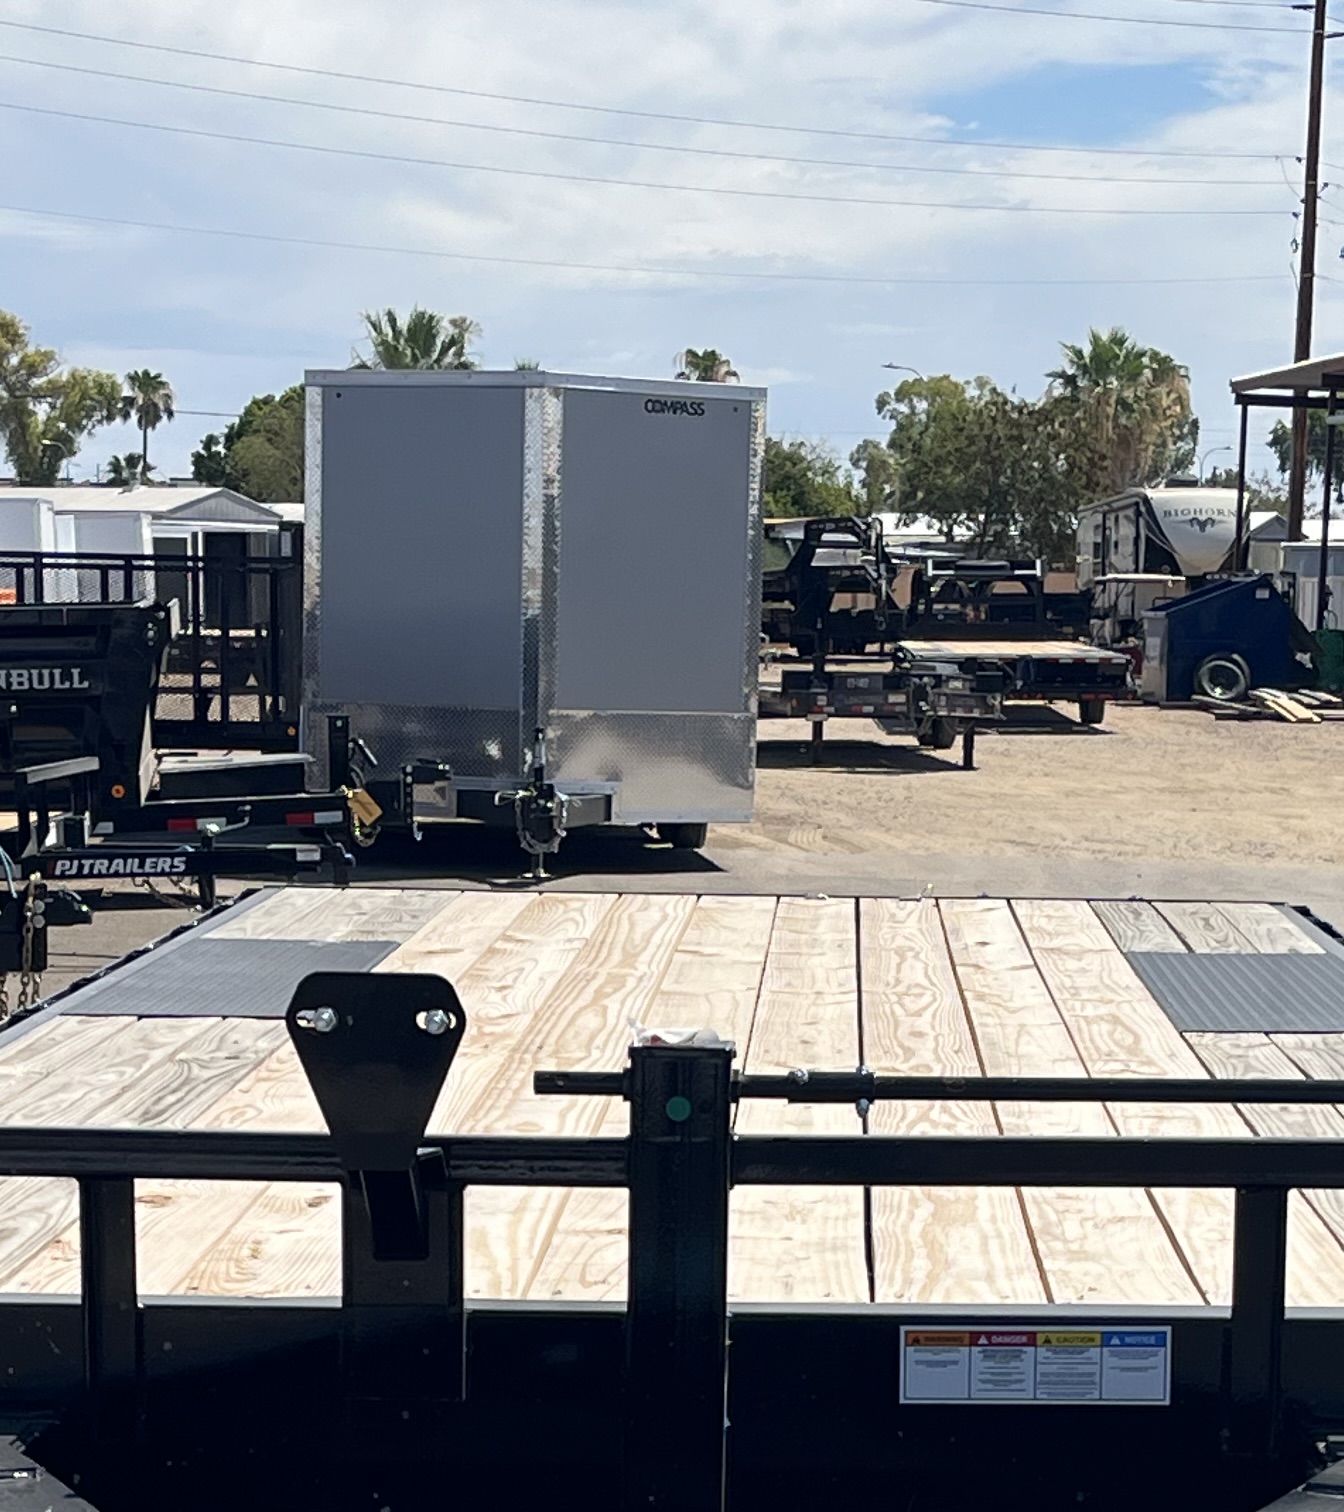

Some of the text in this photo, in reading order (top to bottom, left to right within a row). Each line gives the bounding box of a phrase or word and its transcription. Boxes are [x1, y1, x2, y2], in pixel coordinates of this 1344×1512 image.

[644, 398, 705, 416] COMPASS
[1163, 508, 1237, 517] BIGHORN
[80, 856, 187, 874] TRAILERS
